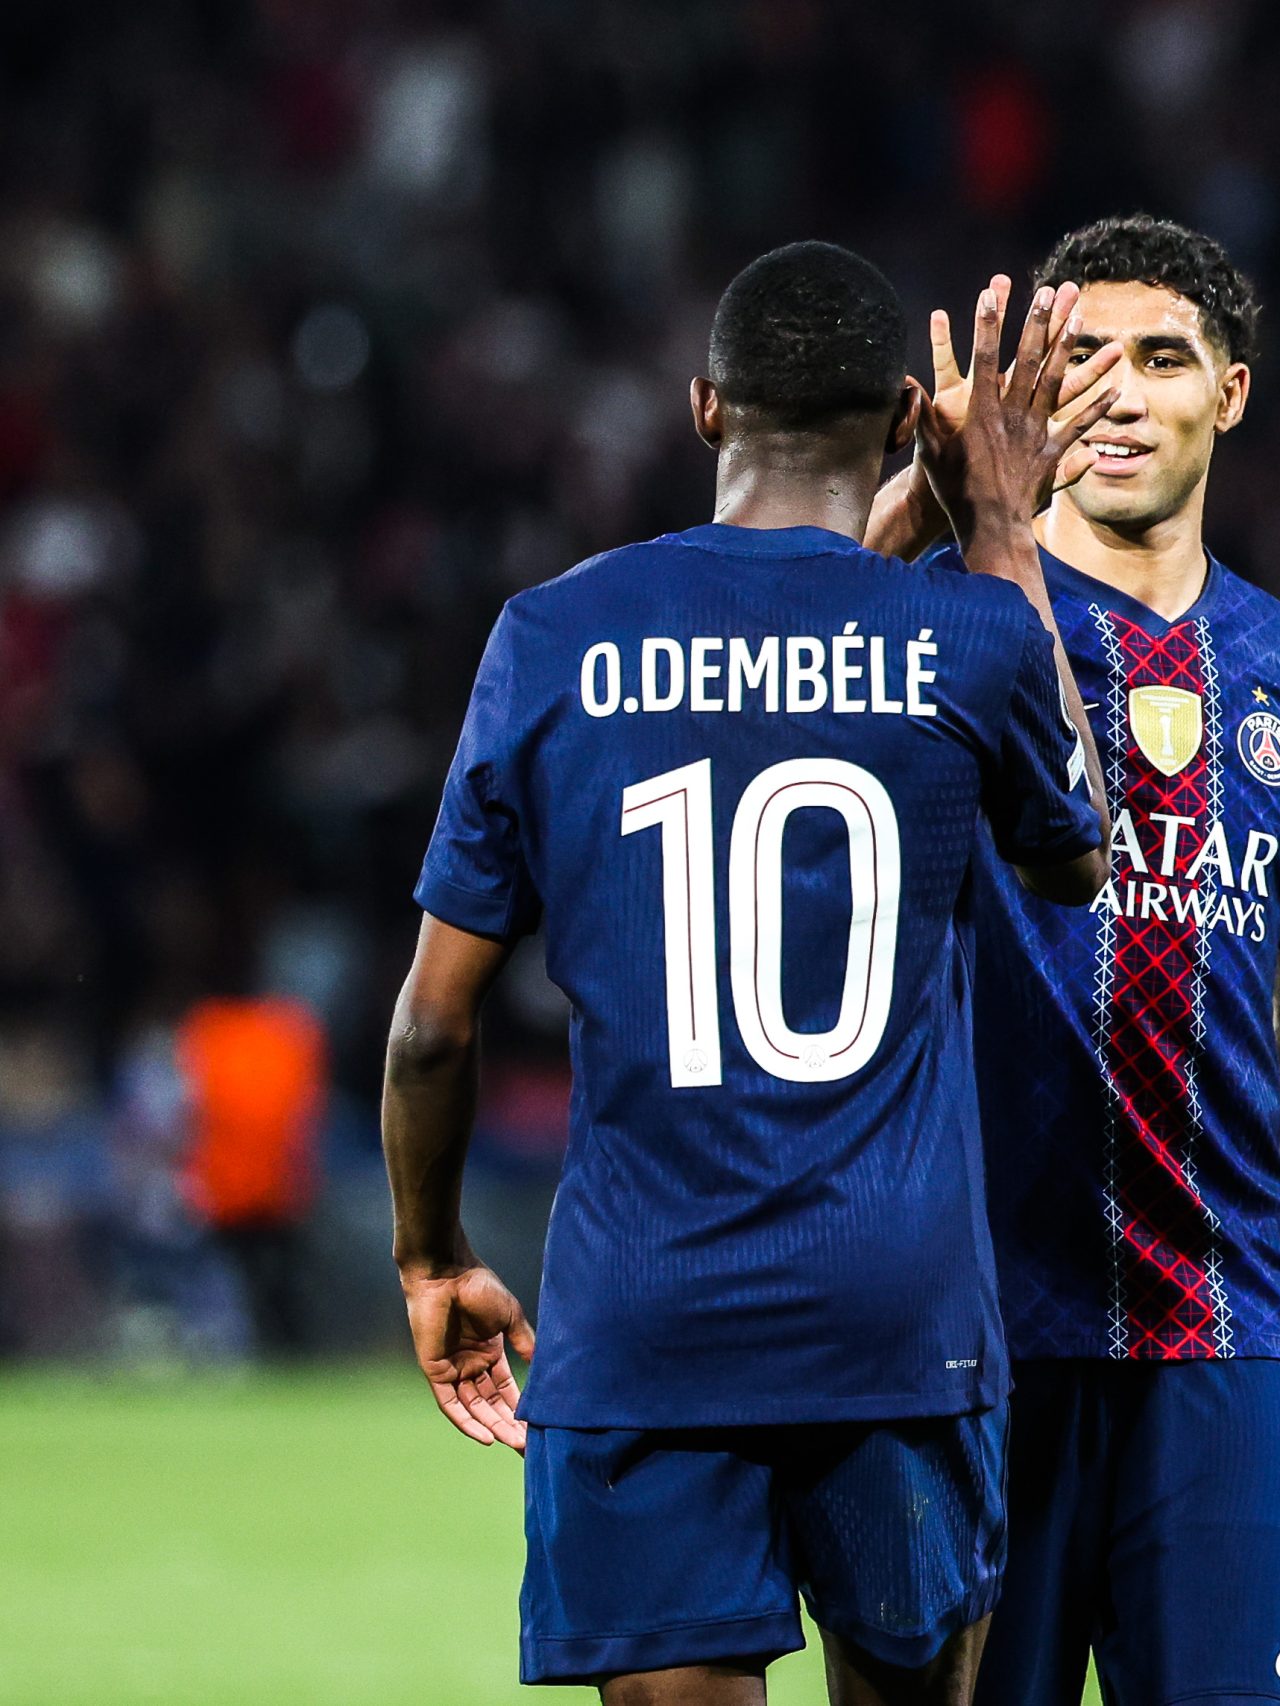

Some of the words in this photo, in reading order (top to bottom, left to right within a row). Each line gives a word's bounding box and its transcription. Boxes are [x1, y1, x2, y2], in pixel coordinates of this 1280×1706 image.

[580, 621, 938, 717] O.DEMBÉLÉ
[1111, 808, 1279, 897] ATAR
[621, 757, 901, 1088] 10
[1088, 877, 1265, 942] AIRWAYS
